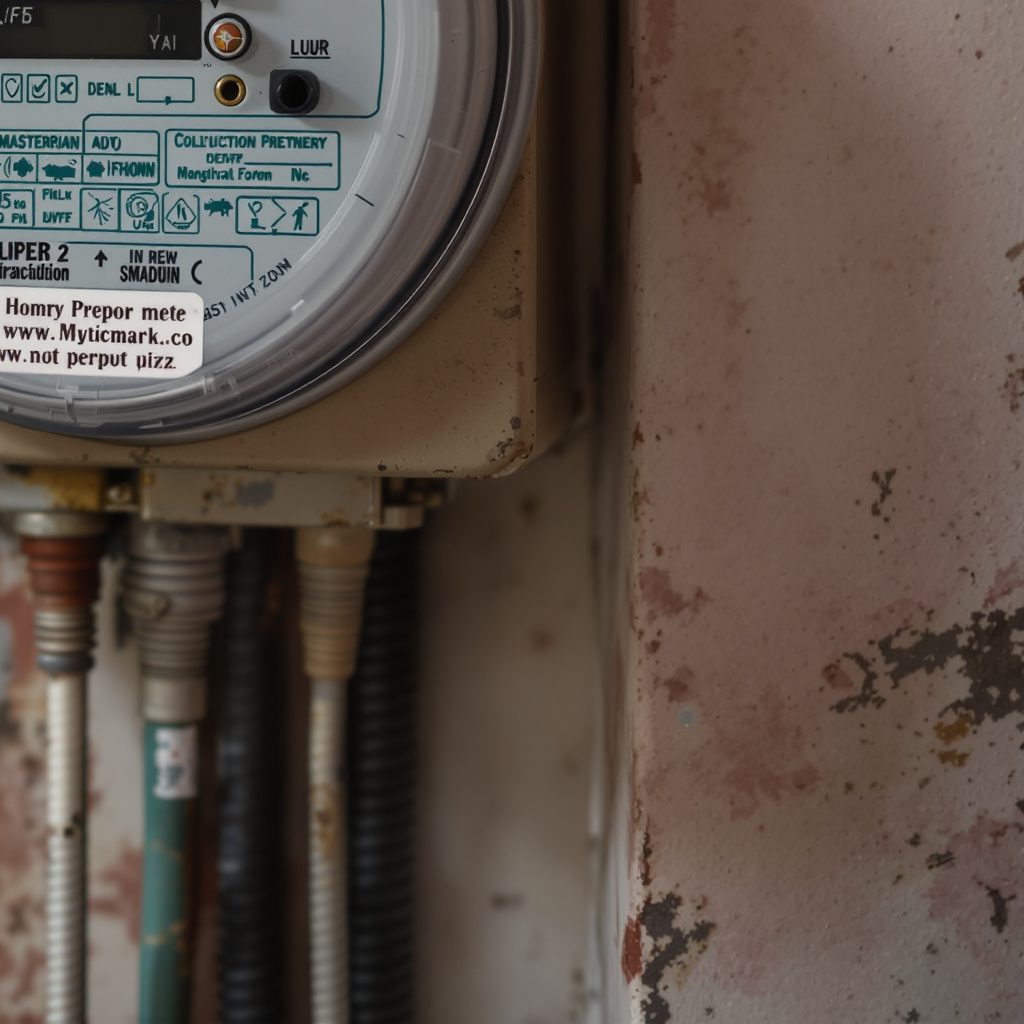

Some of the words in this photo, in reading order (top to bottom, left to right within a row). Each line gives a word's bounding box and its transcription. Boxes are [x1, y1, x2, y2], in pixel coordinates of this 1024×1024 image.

[290, 39, 330, 56] LUUR
[56, 243, 69, 263] 2
[129, 249, 144, 264] IN
[149, 250, 178, 265] REW
[5, 297, 64, 321] Homry
[71, 300, 131, 324] Prepor
[141, 306, 187, 322] mete
[67, 350, 128, 371] perput
